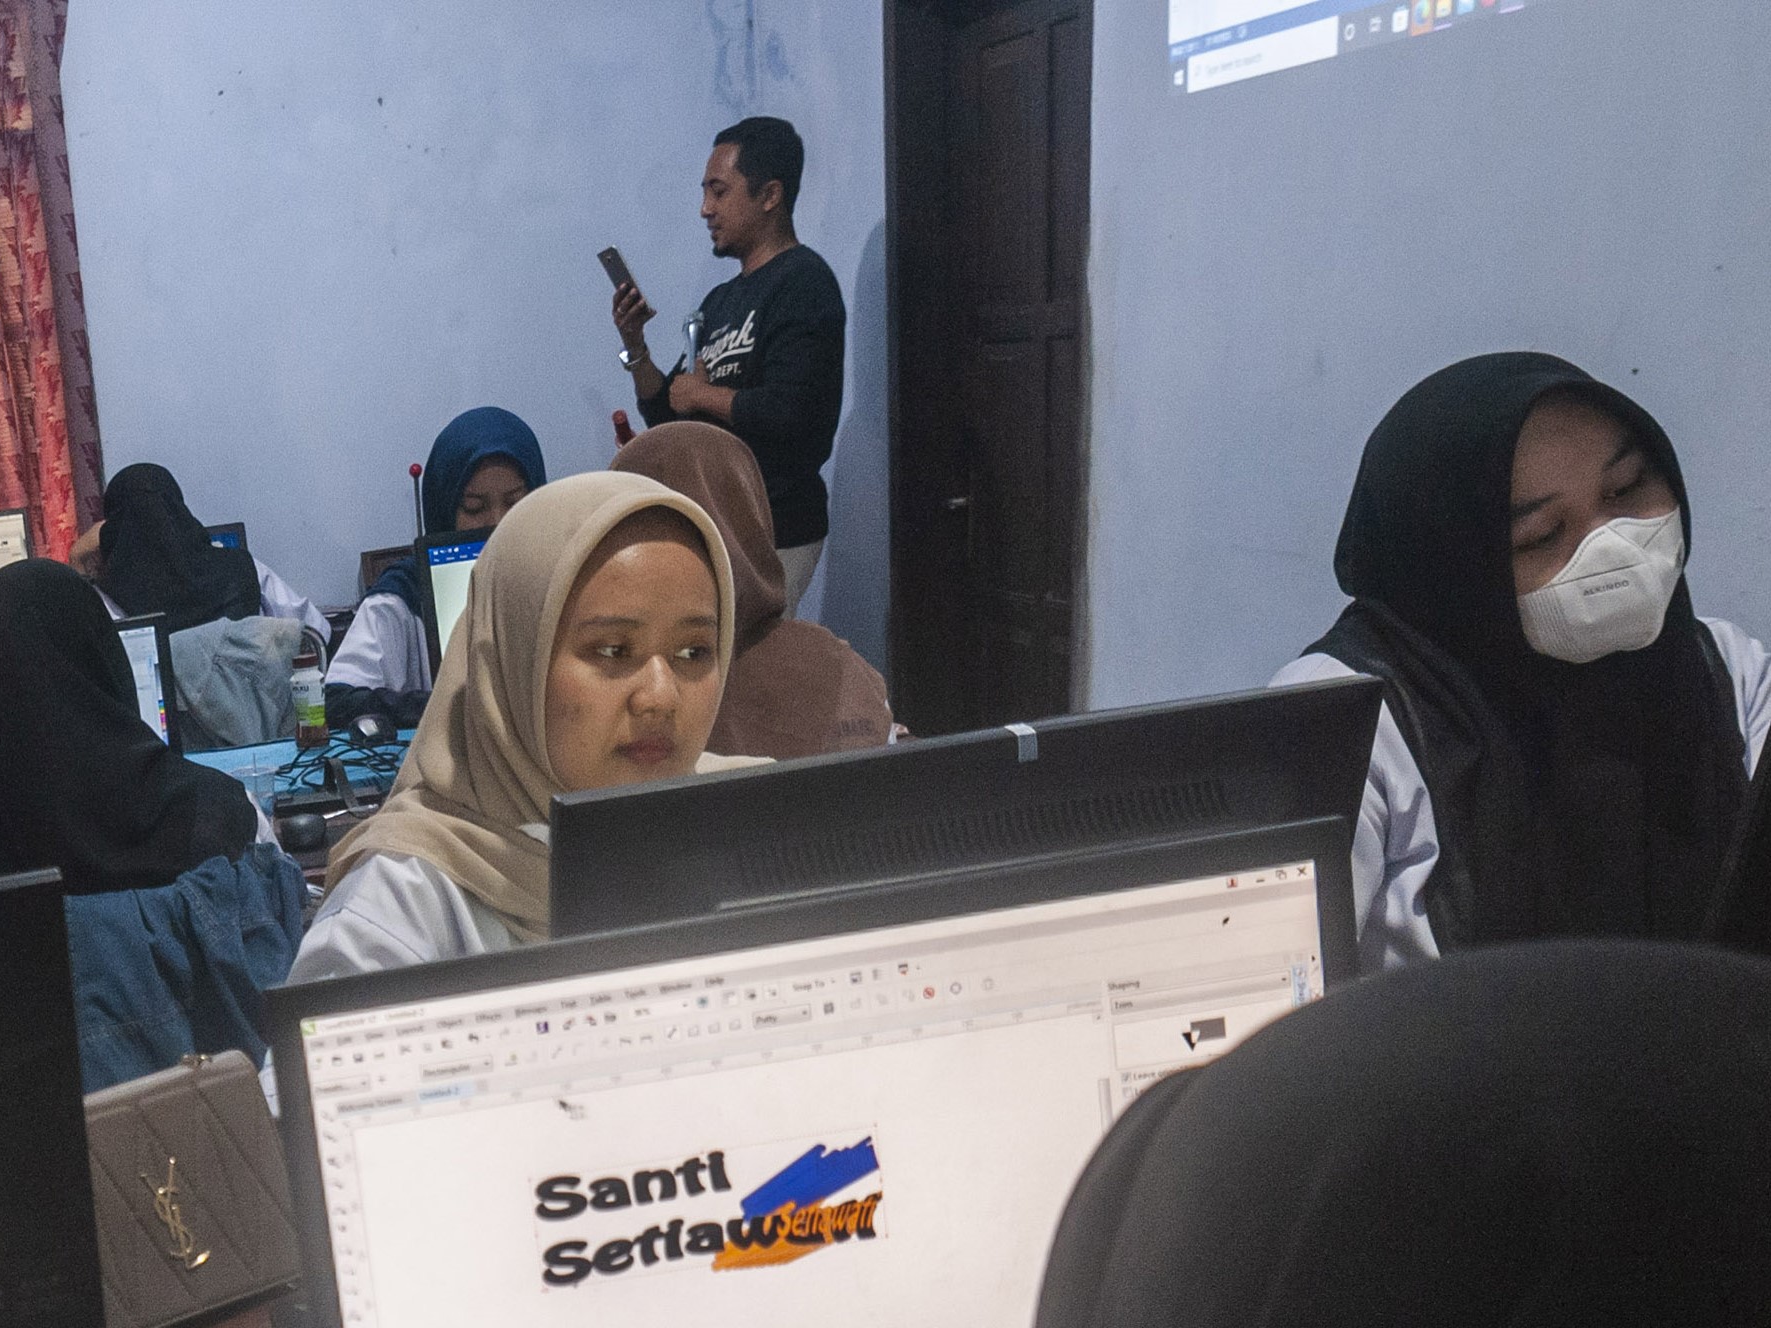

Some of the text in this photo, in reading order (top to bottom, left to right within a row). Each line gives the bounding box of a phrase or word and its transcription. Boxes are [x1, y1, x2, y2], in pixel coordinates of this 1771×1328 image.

[717, 362, 742, 379] DEPT.
[1107, 979, 1141, 992] Shaping
[535, 1150, 733, 1222] Santi
